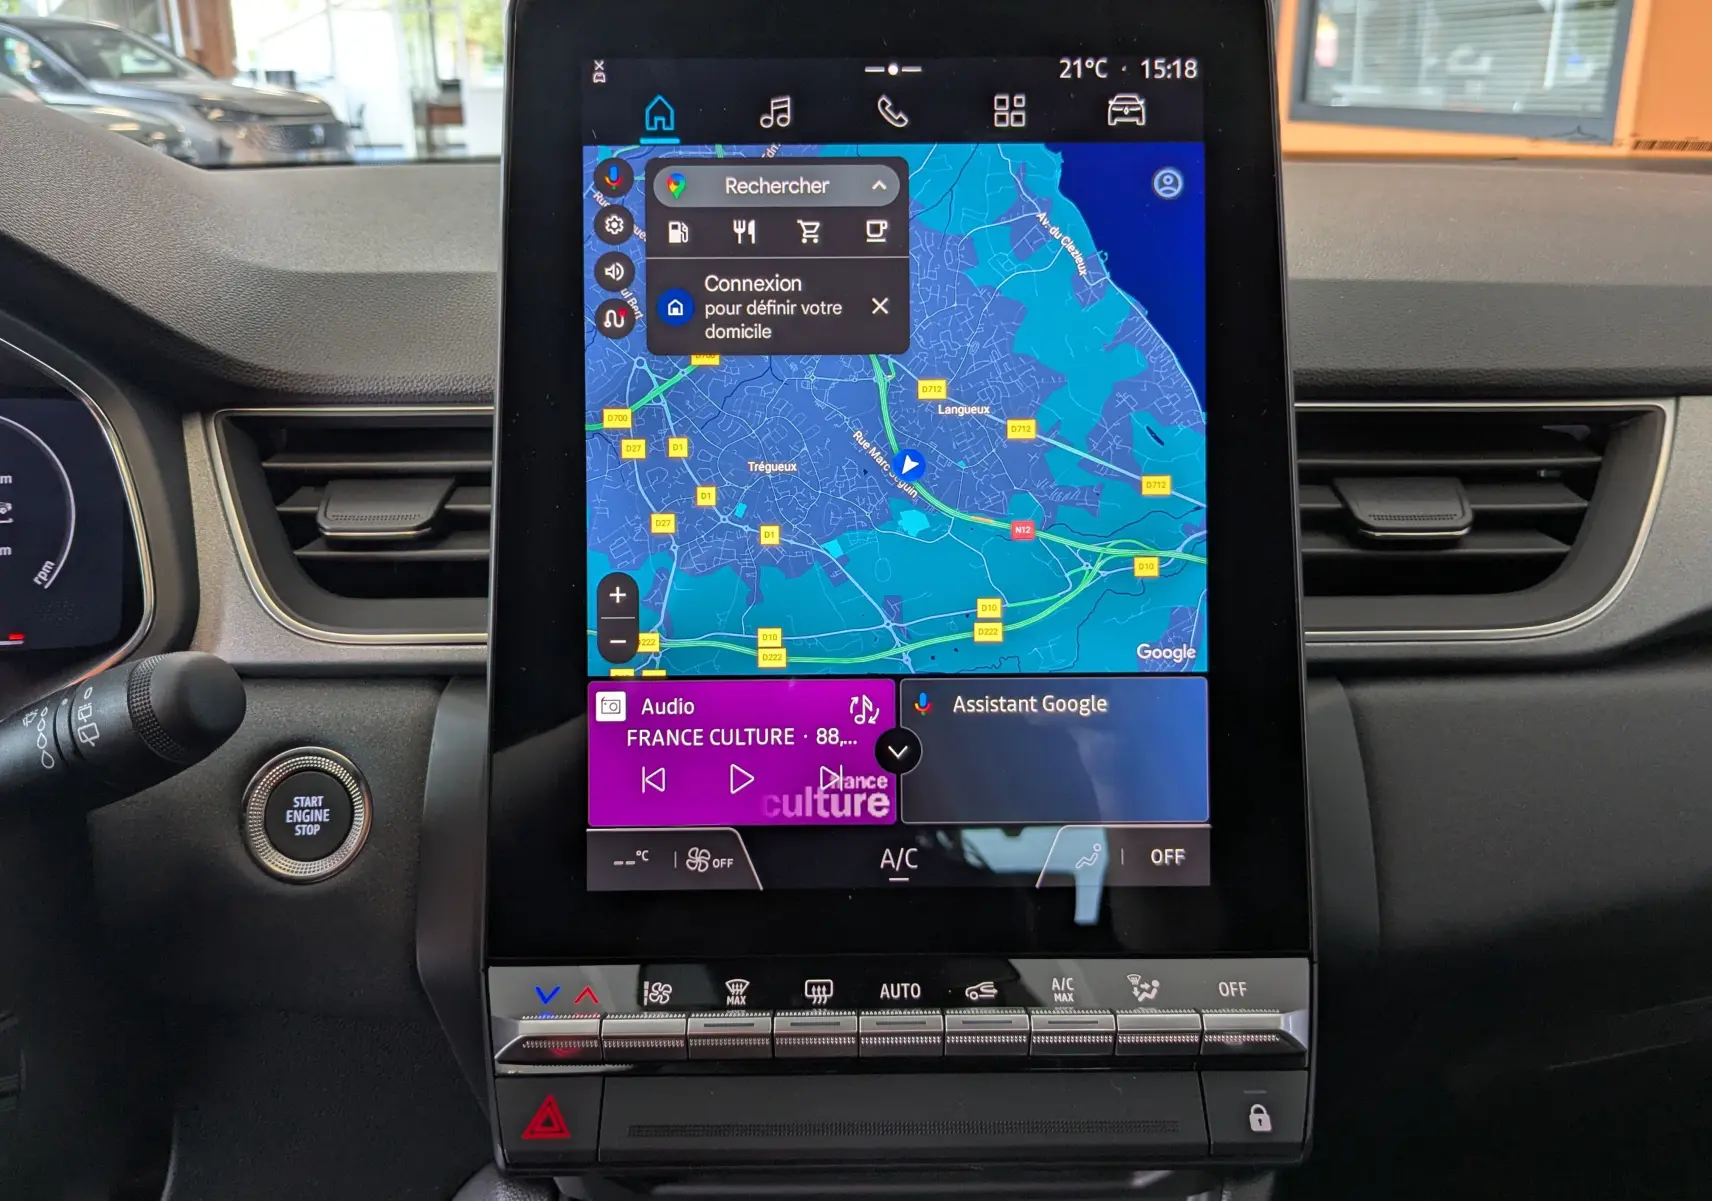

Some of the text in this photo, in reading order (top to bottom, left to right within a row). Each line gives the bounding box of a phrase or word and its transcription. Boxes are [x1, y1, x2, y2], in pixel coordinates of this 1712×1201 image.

[1059, 58, 1198, 79] 21°C 15:18
[725, 176, 831, 195] Rechercher
[1035, 211, 1087, 276] Av. du Clezieux
[704, 273, 802, 292] Connexion
[705, 299, 843, 319] pour définir votre
[705, 323, 772, 339] domicile
[921, 385, 943, 394] D712
[938, 404, 991, 417] Langueux
[607, 414, 628, 422] D700
[1010, 425, 1031, 433] D712
[625, 444, 642, 453] D27
[672, 443, 683, 451] D1
[853, 430, 871, 450] Rue
[868, 446, 891, 472] Marc
[747, 460, 797, 474] Trégueux
[1146, 480, 1167, 489] D712
[700, 491, 711, 500] D1
[655, 519, 672, 527] D27
[1015, 525, 1031, 534] N12
[764, 531, 775, 539] D1
[33, 560, 56, 585] rpm
[1138, 562, 1155, 571] D10
[981, 604, 998, 612] D10
[762, 633, 778, 641] D10
[978, 627, 999, 636] D222
[762, 653, 783, 661] D222
[1136, 643, 1196, 664] Google
[641, 697, 695, 715] Audio
[953, 694, 1108, 717] Assistant Google
[627, 728, 704, 747] FRANCE
[709, 727, 795, 746] CULTURE
[293, 795, 324, 808] START
[763, 786, 890, 818] culture
[285, 808, 330, 823] ENGINE
[294, 823, 321, 836] STOP
[880, 847, 918, 872] A/C
[1150, 848, 1185, 865] OFF
[712, 858, 734, 869] OFF
[879, 982, 921, 999] AUTO
[1051, 977, 1075, 995] A/C
[1218, 981, 1247, 997] OFF
[726, 993, 747, 1006] MAX
[1053, 992, 1075, 1002] MAX
